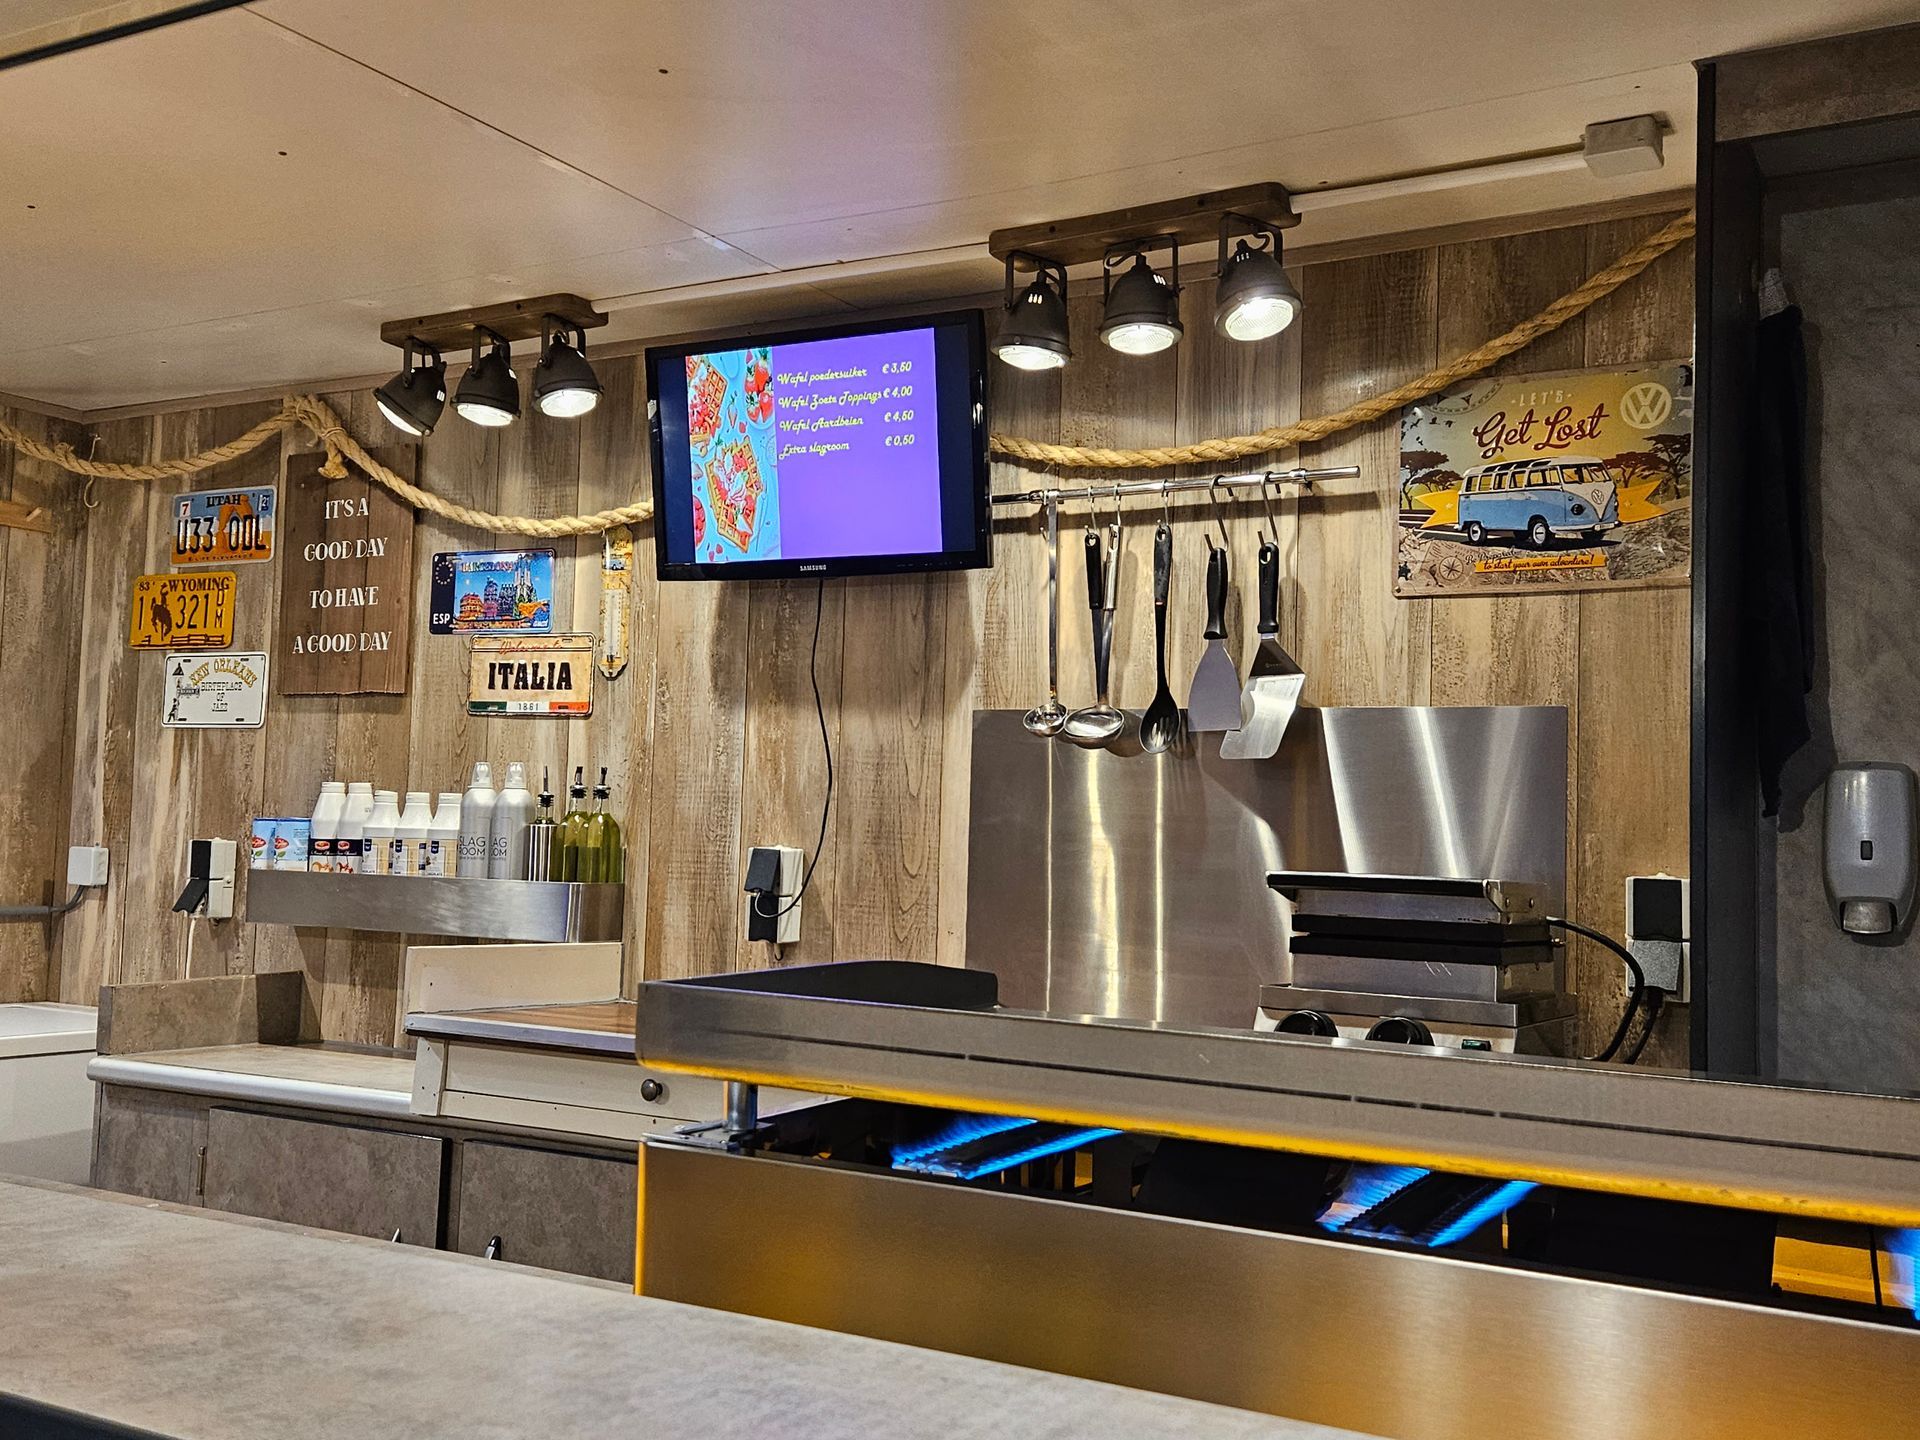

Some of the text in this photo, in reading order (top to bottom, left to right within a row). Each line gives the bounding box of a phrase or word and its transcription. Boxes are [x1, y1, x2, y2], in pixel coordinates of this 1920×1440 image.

[777, 372, 808, 387] Wafel
[808, 366, 867, 386] poedersuiker
[882, 363, 890, 374] €
[778, 386, 912, 411] Wafel Zoete Toppings € 4,00
[779, 419, 810, 435] Wafel
[811, 416, 863, 432] Aardbeien
[884, 412, 892, 422] €
[1472, 403, 1610, 460] Get Lost
[779, 444, 807, 460] Extra
[809, 442, 850, 456] slagroom
[885, 436, 893, 446] €
[206, 494, 241, 508] UTAH
[324, 497, 369, 519] IT'S A
[176, 517, 214, 554] U33
[304, 537, 388, 561] GOOD DAY
[168, 576, 230, 592] WYOMING
[309, 586, 379, 609] TO HAVE
[175, 593, 209, 629] 321
[433, 613, 451, 625] ESP
[292, 631, 392, 654] A GOOD DAY
[488, 662, 572, 690] ITALIA
